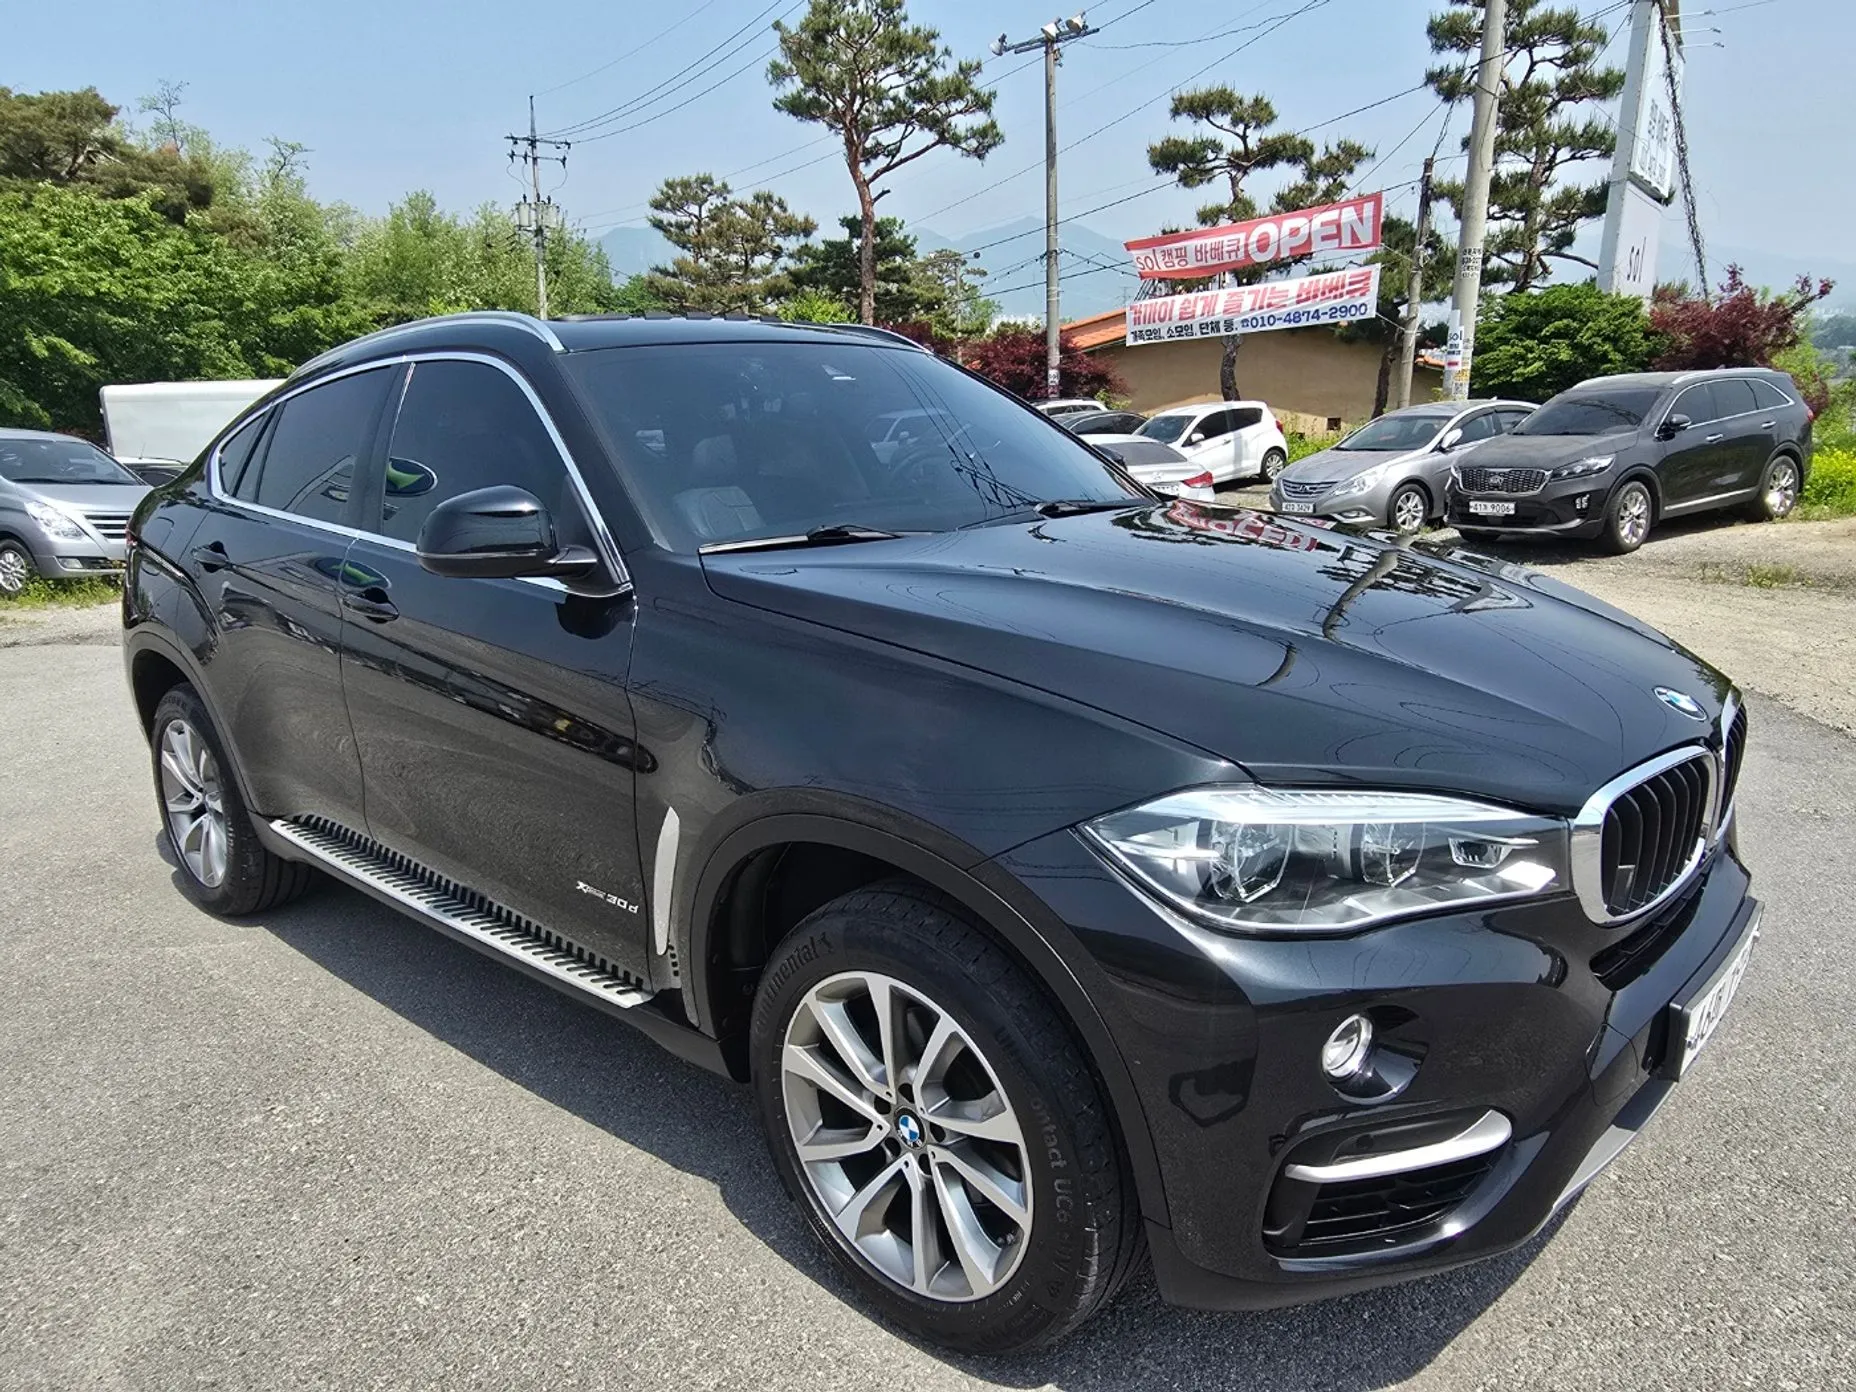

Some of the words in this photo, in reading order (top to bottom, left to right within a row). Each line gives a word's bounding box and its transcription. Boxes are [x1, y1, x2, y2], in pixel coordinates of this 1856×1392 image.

[1195, 238, 1241, 263] 바베큐
[1247, 201, 1375, 263] OPEN
[1167, 322, 1198, 338] 소모임,
[1199, 319, 1221, 335] 단체
[1250, 303, 1368, 328] 010-4874-2900
[1178, 292, 1220, 321] 쉽게
[1222, 286, 1290, 316] 즐기는
[1296, 270, 1373, 305] 바베큐
